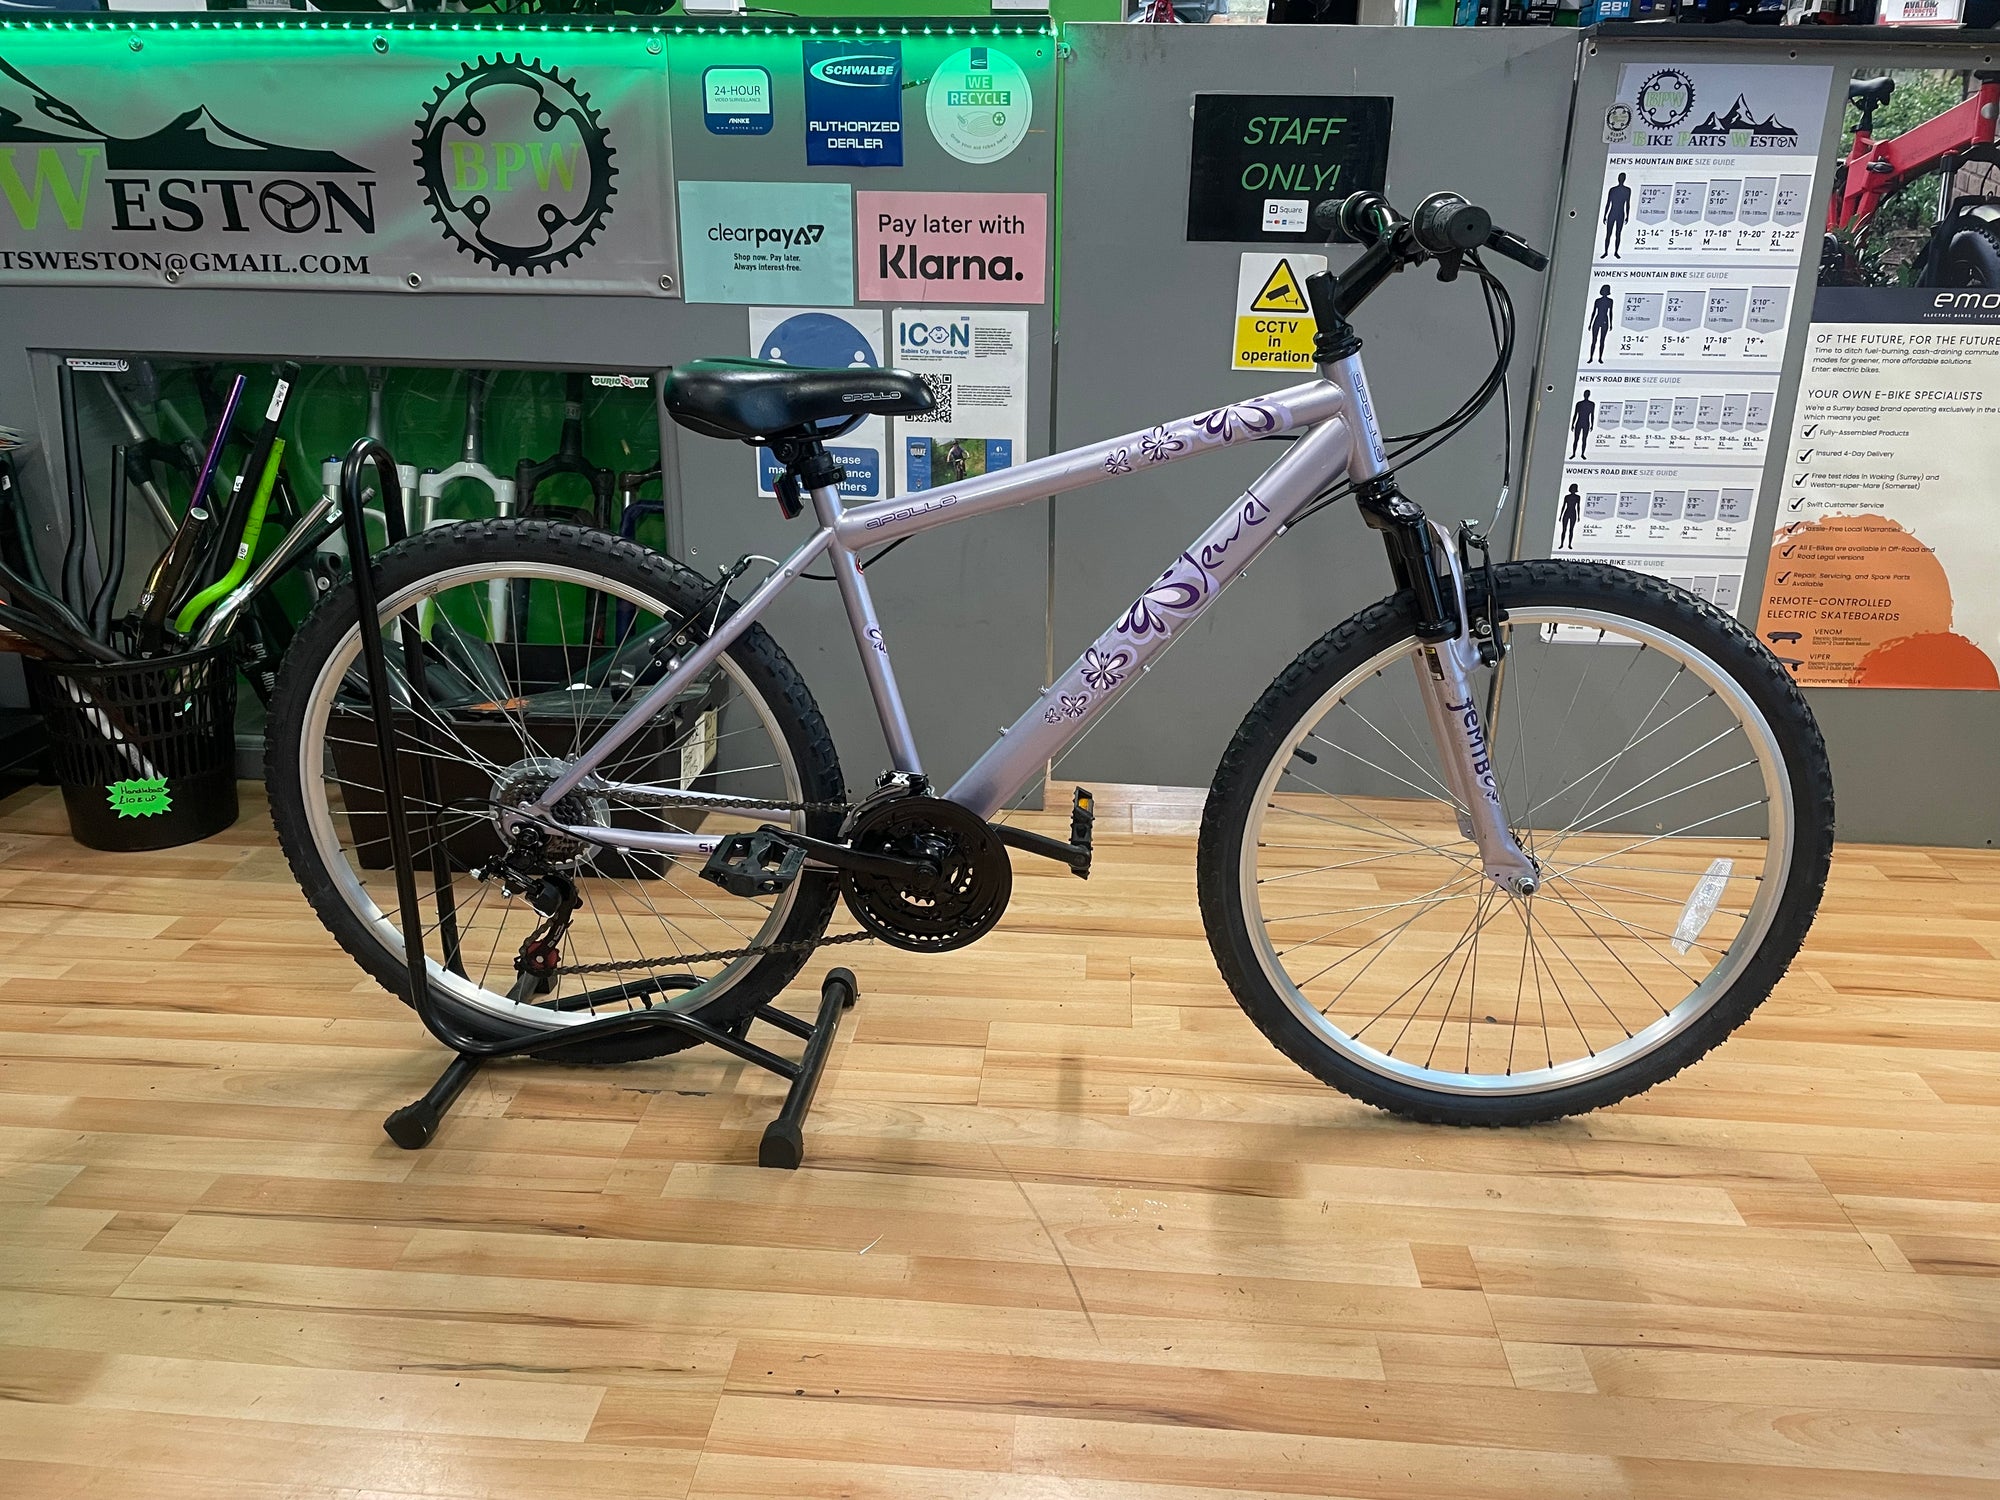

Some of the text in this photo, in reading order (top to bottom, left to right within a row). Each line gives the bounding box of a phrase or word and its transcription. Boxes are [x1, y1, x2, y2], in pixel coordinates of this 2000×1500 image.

[825, 65, 894, 75] SCHWALBE
[968, 77, 990, 89] WE
[714, 86, 761, 96] 24-HOUR
[950, 92, 1008, 105] RECYCLE
[1646, 91, 1685, 108] BPW
[809, 121, 900, 132] AUTHORIZED
[1243, 117, 1348, 145] STAFF
[827, 138, 883, 149] DEALER
[1632, 131, 1673, 147] BIKE
[1677, 131, 1726, 147] PARTS
[449, 140, 582, 193] BPW
[1241, 162, 1341, 191] ONLY!
[1279, 206, 1303, 214] Square
[878, 214, 1025, 237] Pay later with
[707, 223, 794, 250] clearpay
[0, 250, 370, 275] TSWESTON@GMAIL.COM
[734, 253, 751, 261] Shop
[770, 254, 782, 262] Pay
[879, 244, 1024, 281] Klarna.
[734, 263, 757, 272] Always
[1934, 293, 2000, 309] emo
[1255, 320, 1298, 333] CCTV
[900, 322, 970, 348] ICON
[1816, 334, 1832, 344] OF
[1837, 334, 1857, 344] THE
[1861, 335, 1905, 345] FUTURE,
[1909, 335, 1932, 344] FOR
[1936, 336, 1956, 345] THE
[1268, 336, 1281, 348] in
[1241, 350, 1310, 364] operation
[1808, 390, 1983, 400] YOUR OWN E-BIKE SPECIALISTS
[1832, 405, 1855, 413] Surrey
[1938, 406, 1975, 414] exclusively
[833, 454, 861, 465] lease
[1896, 473, 1924, 481] (Surrey)
[1882, 482, 1920, 490] (Somerset)
[1769, 596, 1891, 608] REMOTE-CONTROLLED
[1767, 610, 1900, 621] ELECTRIC SKATEBOARDS
